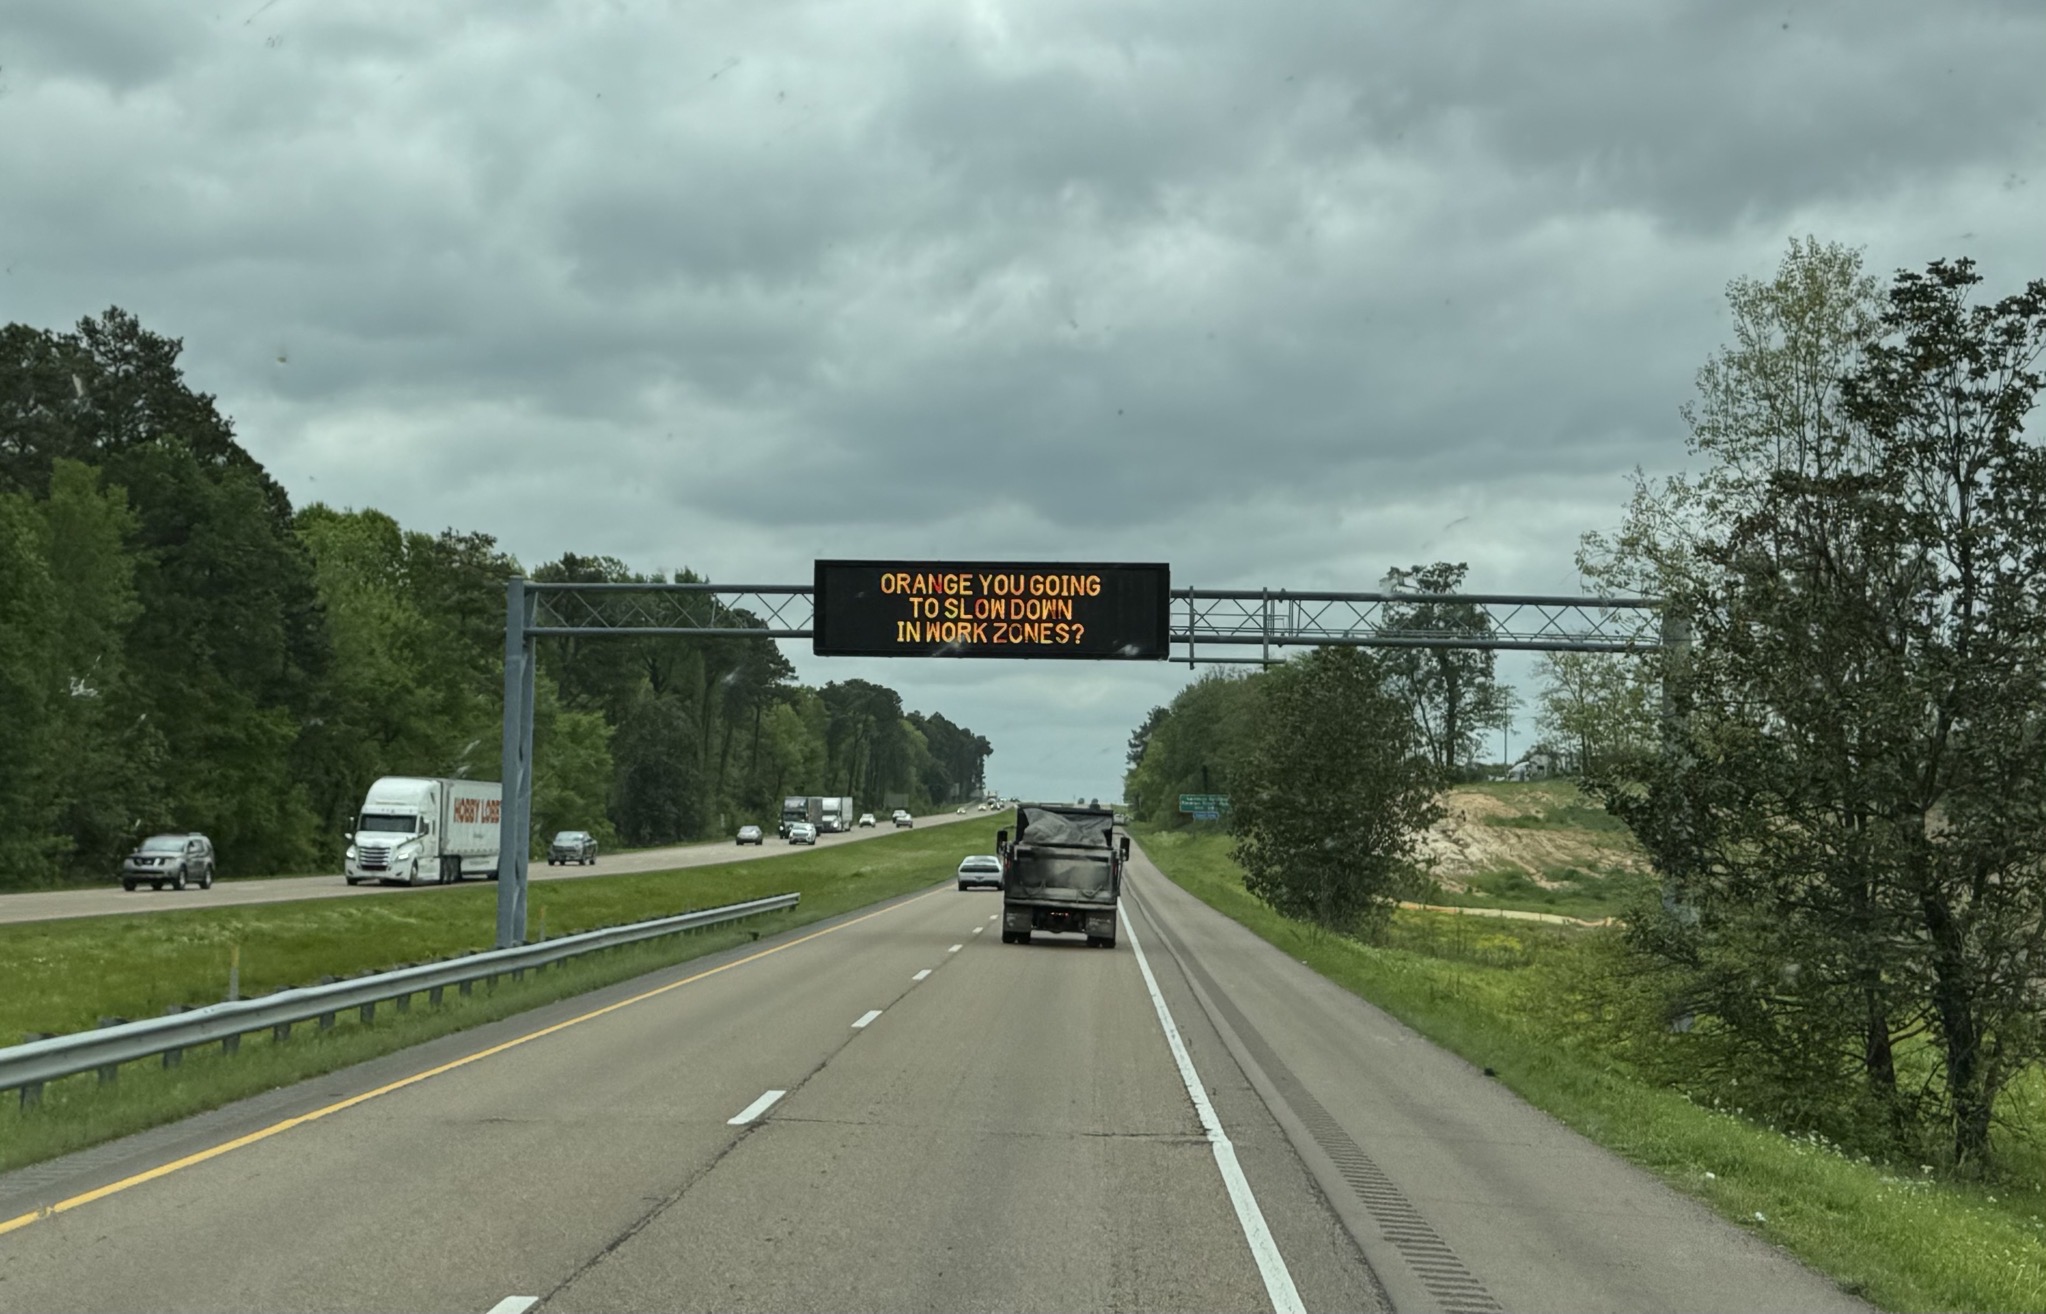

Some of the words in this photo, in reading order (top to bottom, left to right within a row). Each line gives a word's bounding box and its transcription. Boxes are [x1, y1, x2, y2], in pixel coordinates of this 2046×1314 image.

[881, 573, 973, 595] ORANGE
[979, 574, 1025, 596] YOU
[1029, 575, 1101, 596] GOING
[909, 597, 939, 619] TO
[944, 598, 1005, 620] SLOW
[1010, 599, 1072, 620] DOWN
[896, 621, 921, 643] IN
[926, 622, 988, 644] WORK
[993, 623, 1085, 644] ZONES?
[454, 797, 480, 823] HOBBY
